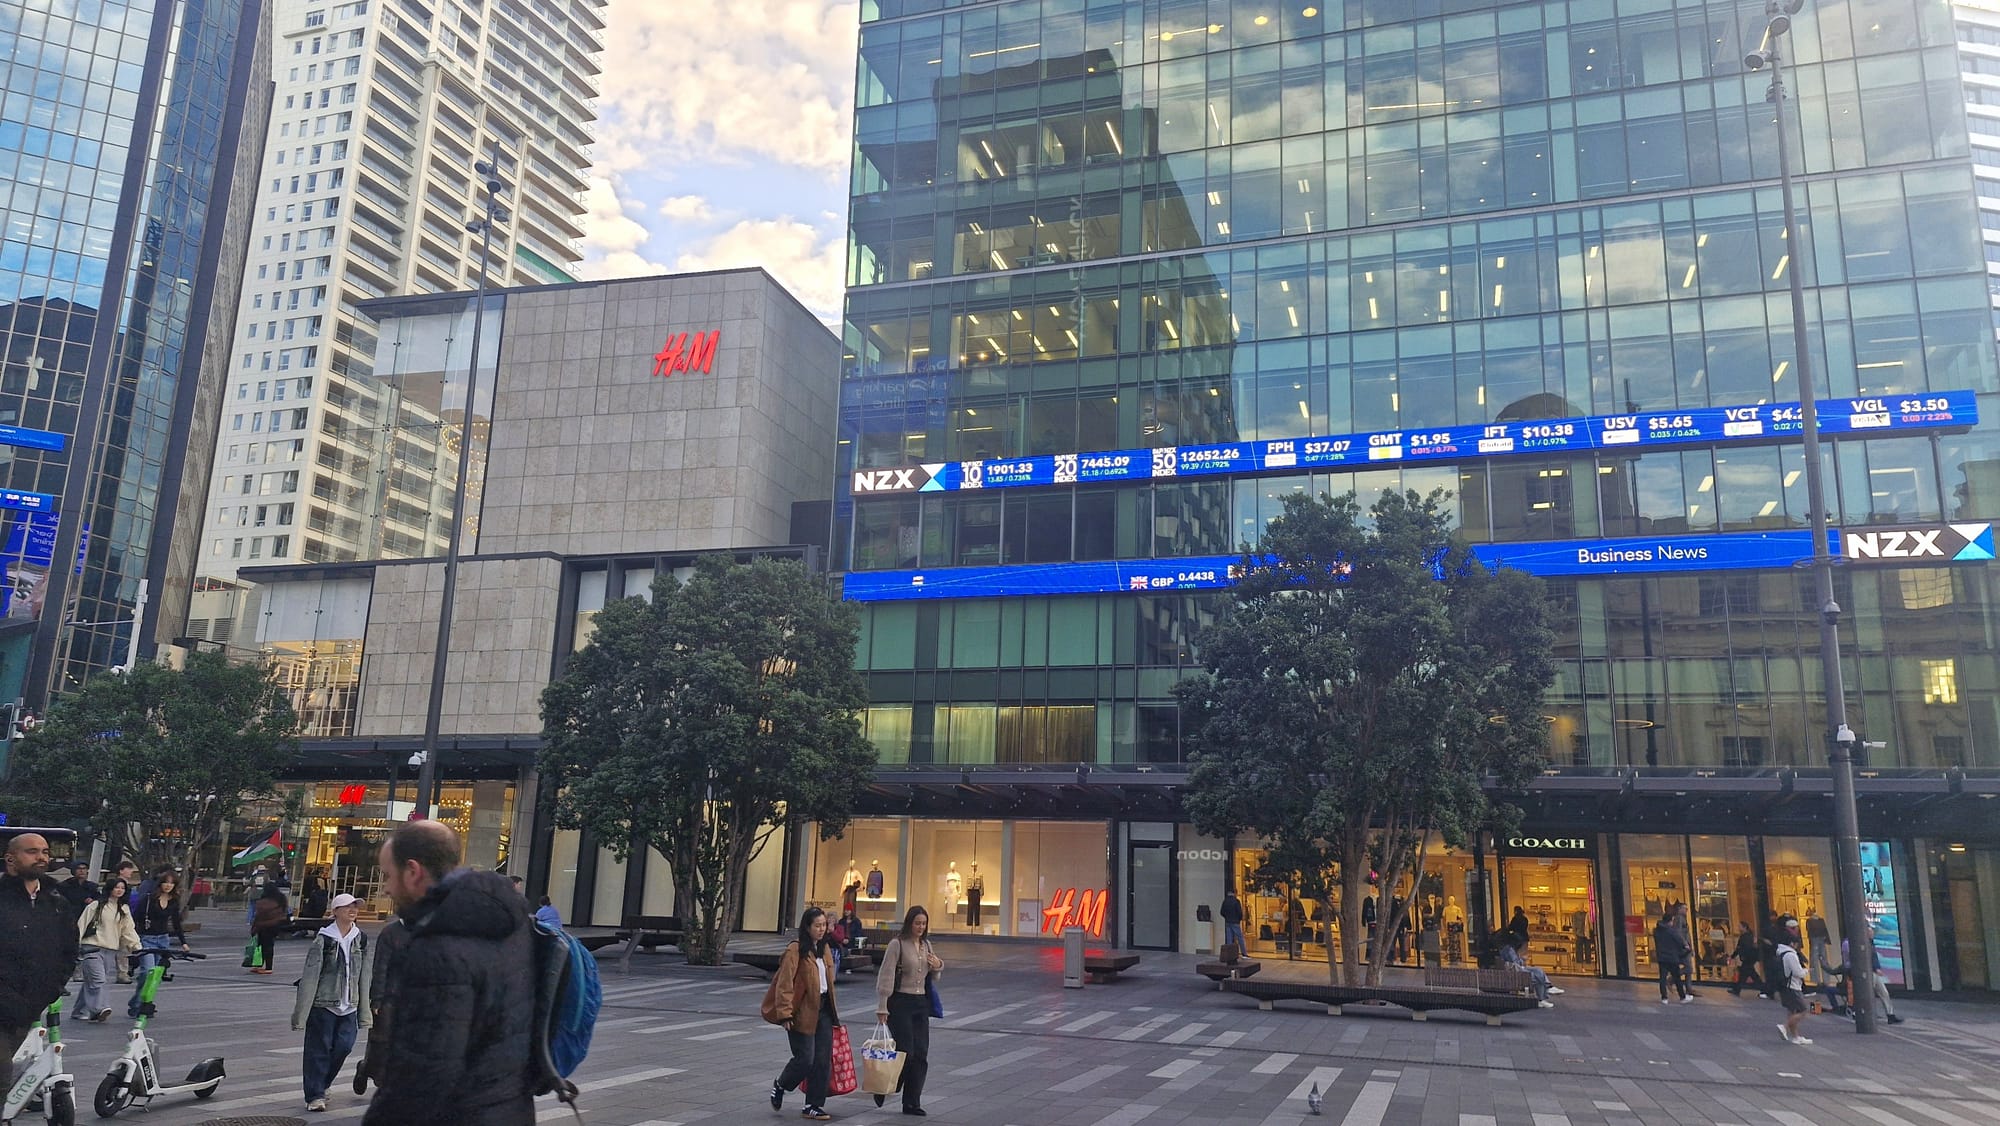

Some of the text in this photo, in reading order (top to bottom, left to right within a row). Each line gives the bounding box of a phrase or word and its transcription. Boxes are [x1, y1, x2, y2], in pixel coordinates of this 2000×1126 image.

[653, 329, 720, 377] H&M
[1851, 399, 1888, 413] VGL
[1900, 399, 1948, 413] $3.50
[1725, 408, 1759, 421] VCT
[1772, 407, 1817, 421] $4.2
[1604, 416, 1637, 430] USV
[1648, 416, 1693, 430] $5.65
[1484, 425, 1508, 438] IFT
[1522, 424, 1574, 438] $10.38
[1368, 433, 1403, 446] GMT
[1411, 433, 1451, 447] $1.95
[1267, 441, 1294, 454] FPH
[1304, 440, 1351, 455] $37.07
[1152, 453, 1177, 470] 50
[1180, 448, 1240, 462] 12652.26
[987, 463, 1033, 475] 1901.33
[1053, 459, 1077, 476] 20
[1081, 456, 1130, 469] 7445.09
[962, 466, 982, 482] 10
[1053, 474, 1078, 483] INDEX
[1151, 468, 1177, 477] INDEX
[854, 468, 915, 492] NZX
[960, 481, 983, 489] INDEX
[1846, 530, 1945, 558] NZX
[1578, 545, 1708, 563] Business News
[1151, 577, 1174, 587] GBP
[1178, 571, 1215, 581] 0.4438
[1508, 837, 1586, 849] COACH
[1042, 887, 1108, 937] H&M
